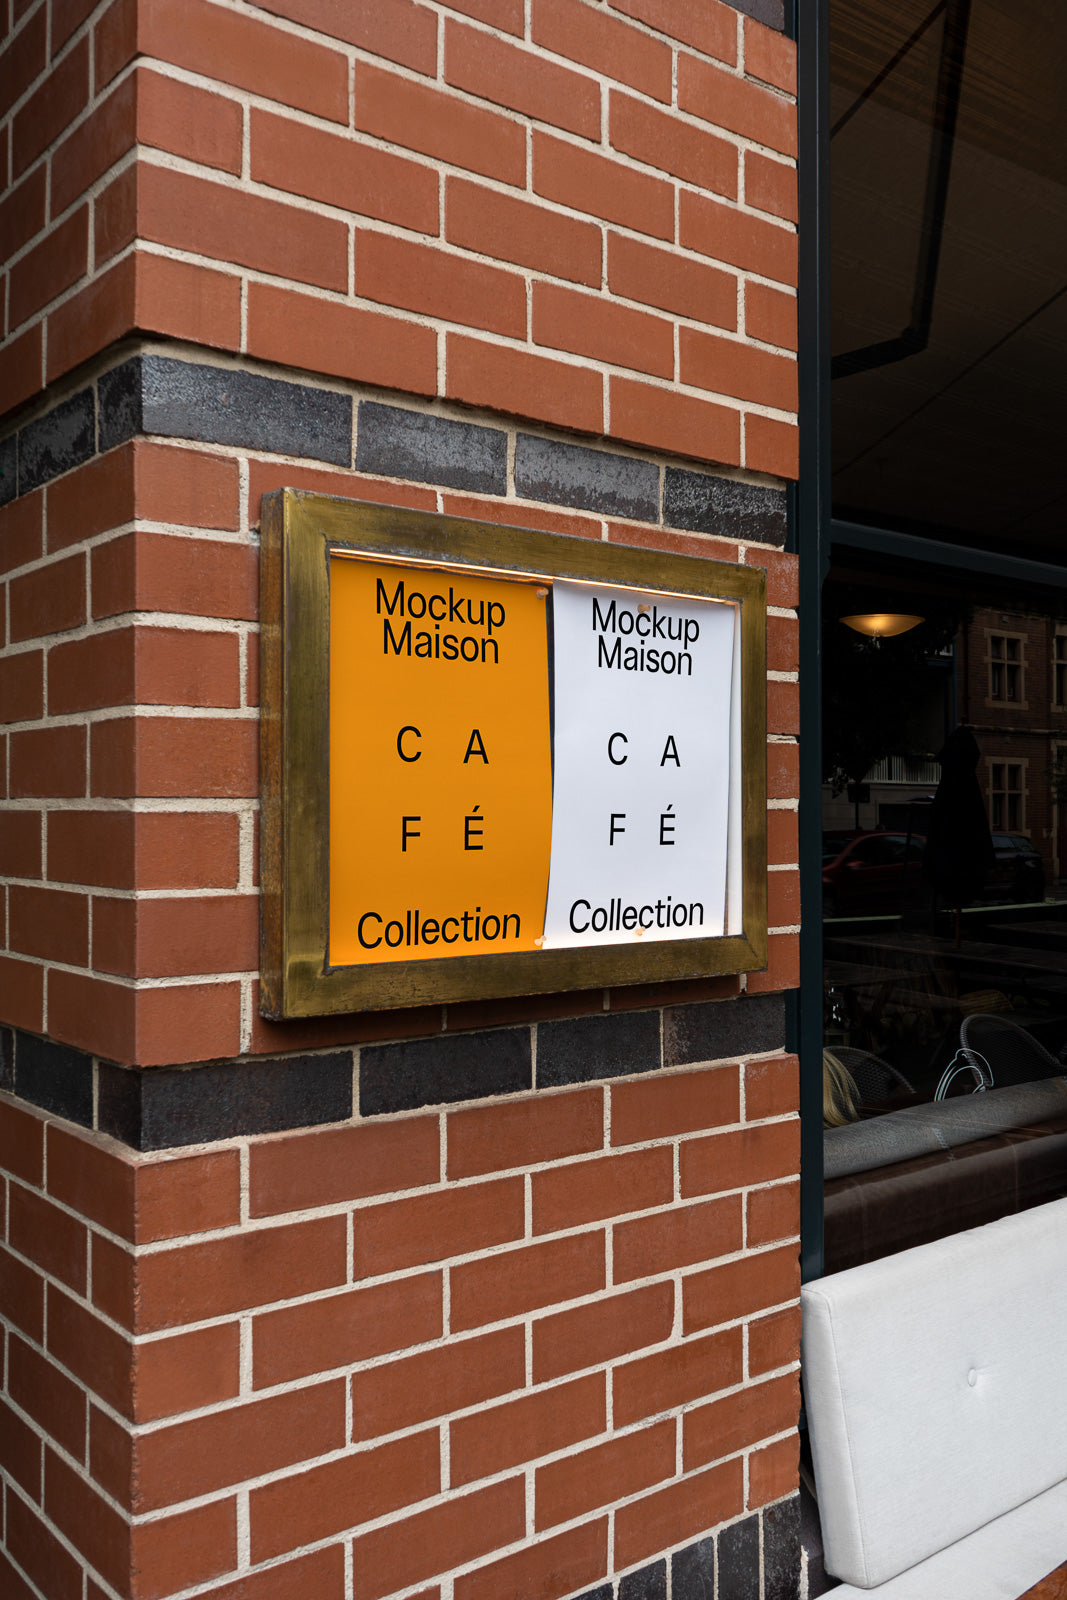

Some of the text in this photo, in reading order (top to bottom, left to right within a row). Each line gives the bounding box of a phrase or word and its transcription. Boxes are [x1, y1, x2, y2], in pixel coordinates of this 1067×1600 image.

[376, 577, 506, 636] Mockup
[592, 597, 700, 650] Mockup
[383, 618, 499, 664] Maison
[598, 634, 692, 675] Maison
[396, 725, 489, 765] C A
[607, 732, 681, 767] C A
[401, 805, 484, 852] F É
[609, 804, 676, 846] F É
[357, 906, 521, 950] Collection
[569, 895, 704, 934] Collection
